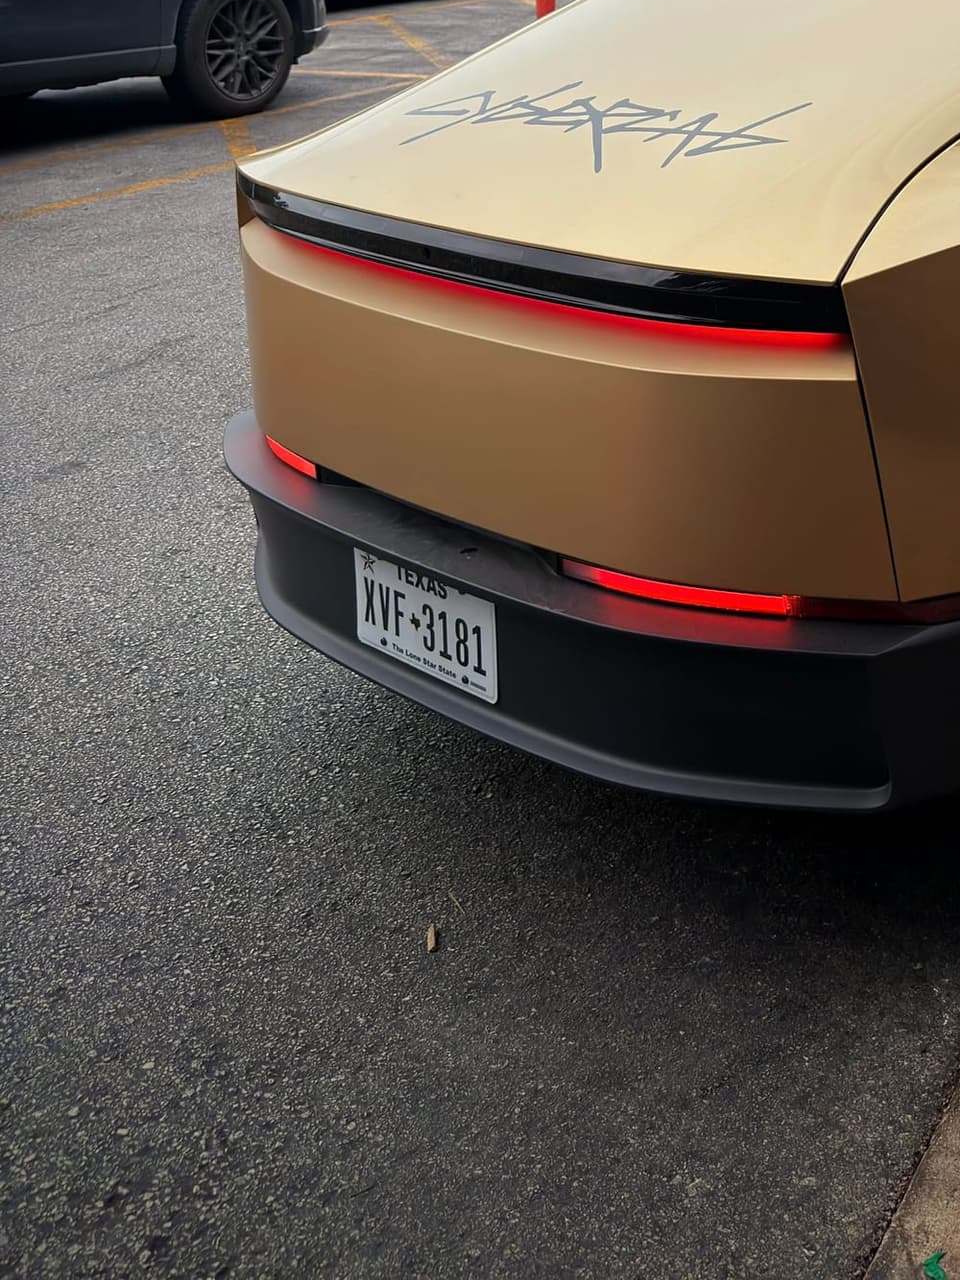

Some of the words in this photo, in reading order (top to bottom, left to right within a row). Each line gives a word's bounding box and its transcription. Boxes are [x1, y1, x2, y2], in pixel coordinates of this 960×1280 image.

[397, 566, 448, 600] TEXAS
[392, 643, 404, 654] The
[405, 649, 421, 662] Lone
[423, 657, 437, 669] Star
[438, 665, 457, 679] State
